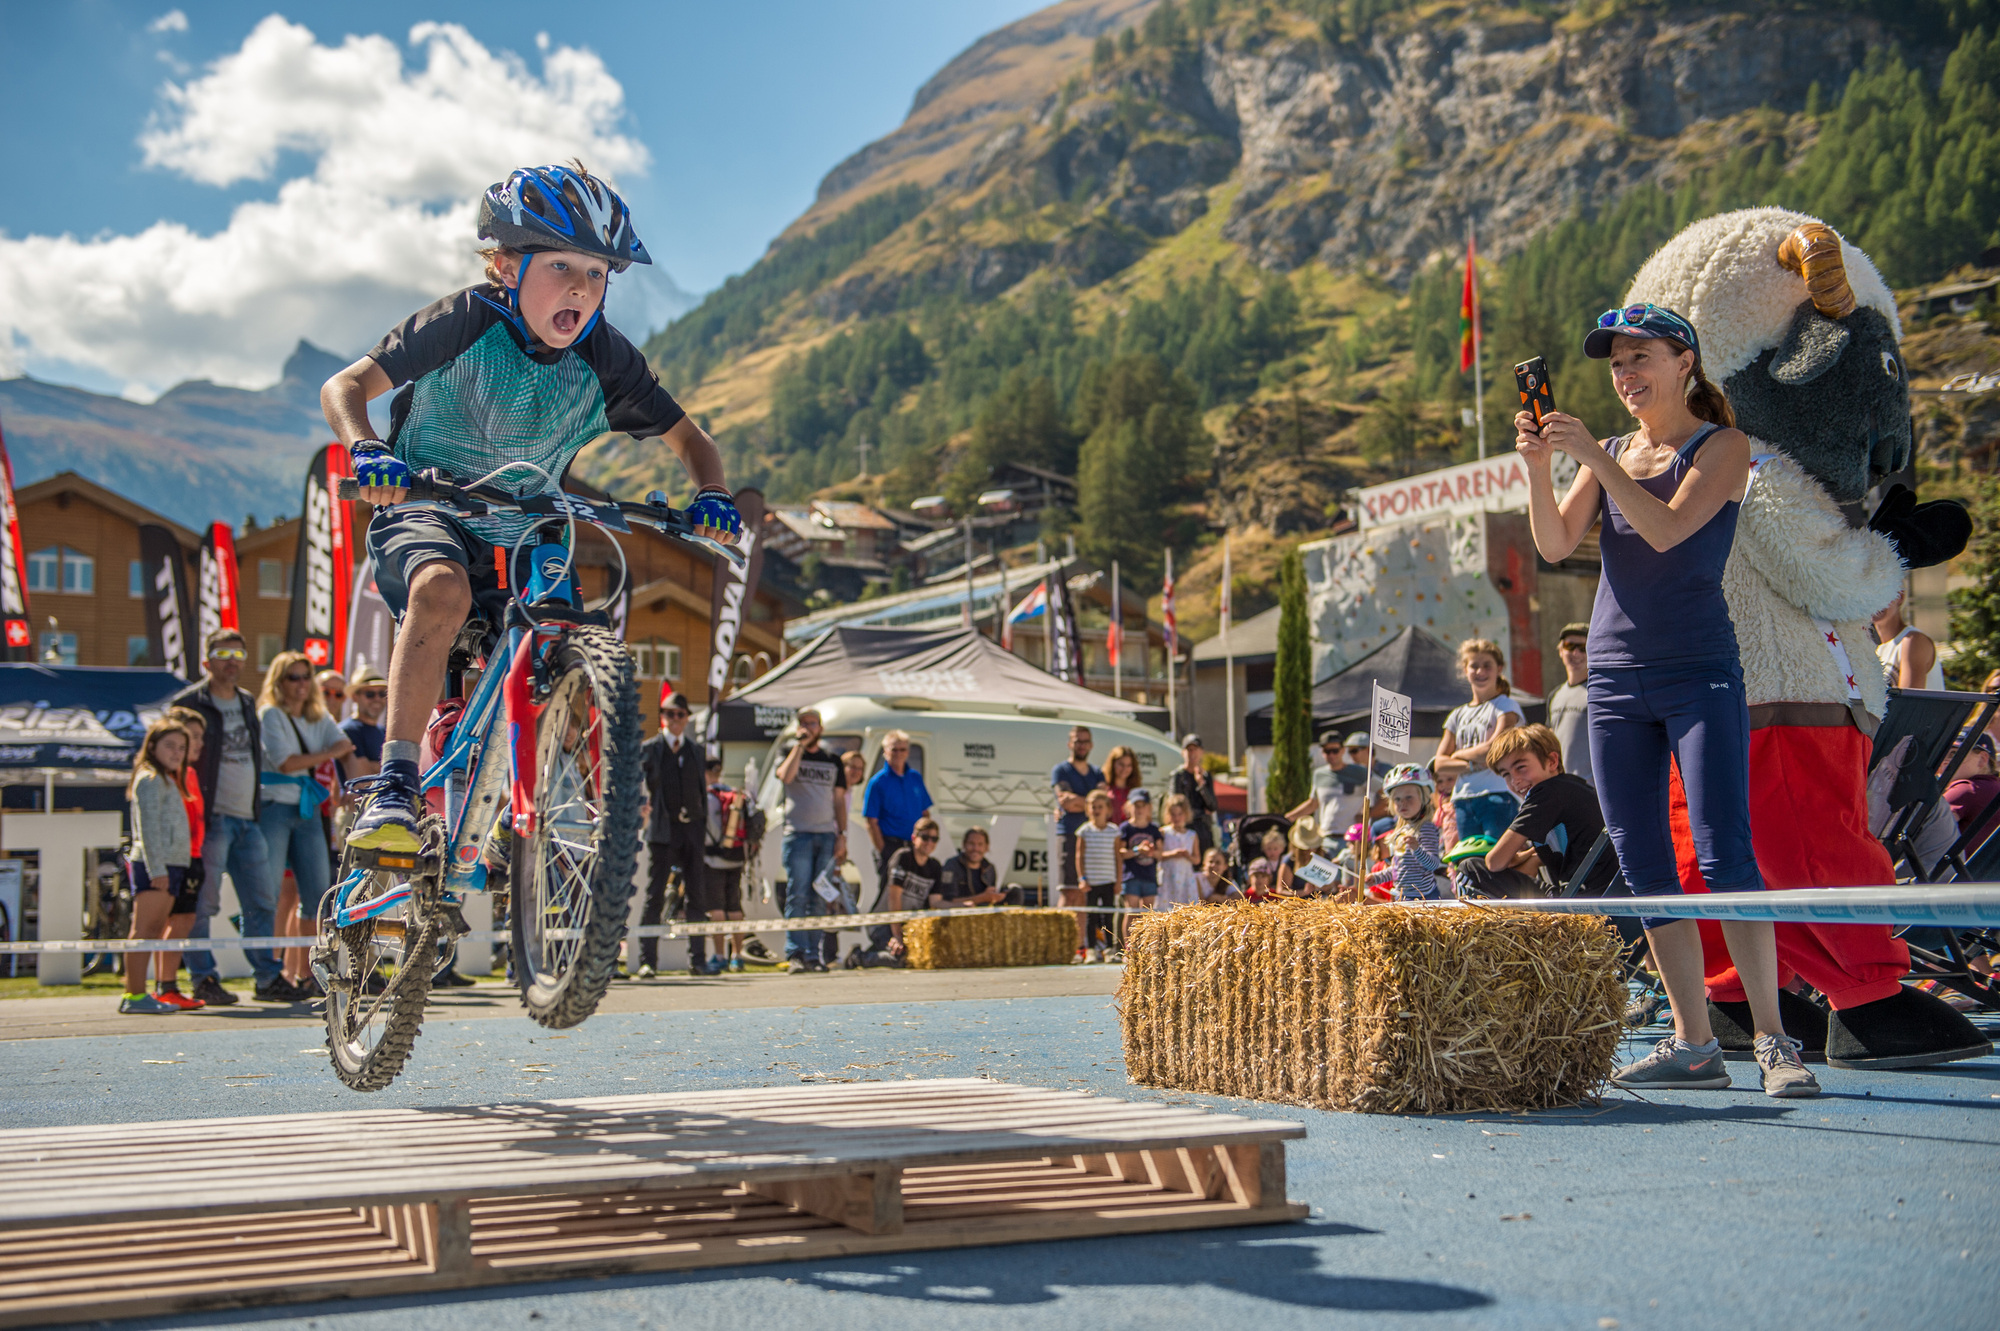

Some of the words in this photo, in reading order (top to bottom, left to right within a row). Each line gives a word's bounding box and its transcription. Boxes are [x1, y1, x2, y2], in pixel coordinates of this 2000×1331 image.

[1367, 461, 1527, 520] SPORTARENA
[552, 500, 598, 519] 52
[964, 743, 994, 751] MONS
